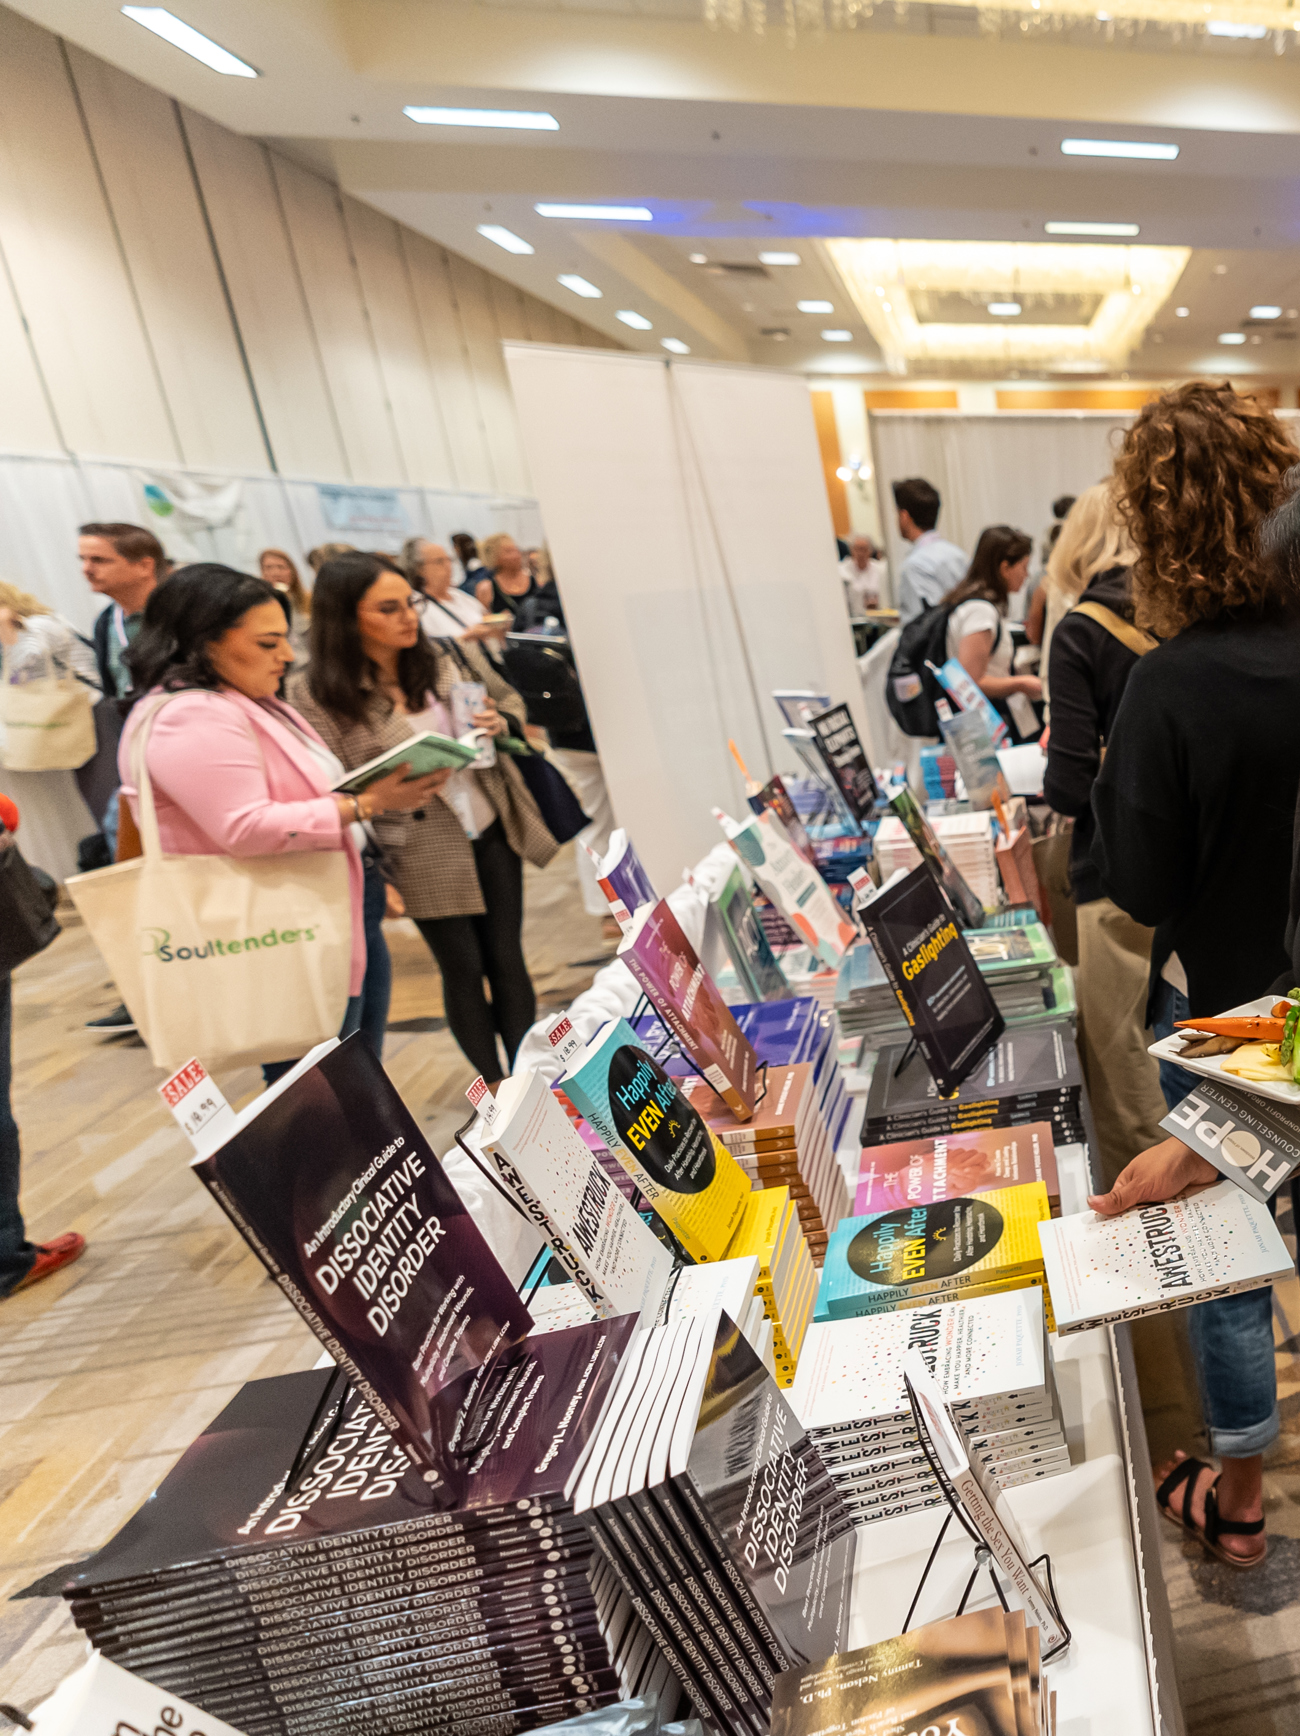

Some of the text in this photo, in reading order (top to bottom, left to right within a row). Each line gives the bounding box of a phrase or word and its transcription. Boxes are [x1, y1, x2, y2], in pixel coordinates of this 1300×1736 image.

[159, 925, 316, 962] Soultenders
[902, 922, 958, 981] Gaslighting
[627, 957, 641, 972] THE
[637, 971, 660, 997] POWER
[655, 996, 668, 1009] OF
[664, 1006, 699, 1052] ATTACHMENT
[681, 962, 706, 1022] ATTACHMENT
[550, 1020, 572, 1046] SALE
[164, 1065, 203, 1102] SALE
[616, 1059, 658, 1111] Happily
[627, 1099, 665, 1151] EVEN
[654, 1077, 678, 1113] After
[1168, 1093, 1291, 1192] HOPE
[1200, 1084, 1300, 1158] COUNSELING CENTER
[587, 1112, 660, 1201] HAPPILY EVEN AFTER
[907, 1166, 924, 1201] POWER
[932, 1139, 948, 1202] TTACHMENT
[303, 1133, 405, 1260] An Introductory Clinical Guide to
[314, 1152, 426, 1296] DISSOCIATIVE
[491, 1151, 604, 1304] AWESTRUCK
[571, 1160, 612, 1260] AWESTRUCK
[353, 1193, 424, 1301] IDENTITY
[366, 1216, 447, 1337] DISORDER
[869, 1222, 902, 1275] Happily
[902, 1207, 928, 1280] EVEN After
[868, 1275, 972, 1304] HAPPILY EVEN AFTER
[1066, 1286, 1232, 1332] AWESTRUCK
[275, 1271, 401, 1433] DISSOCIATIVE IDENTITY DISORDER
[943, 1345, 952, 1379] EMBRACING
[945, 1317, 955, 1347] WONDER
[964, 1345, 972, 1363] MORE
[965, 1314, 974, 1346] CONNECTED
[952, 1372, 960, 1390] MAKE
[743, 1404, 787, 1569] DISSOCIATIVE
[763, 1446, 794, 1564] IDENTITY
[224, 1514, 452, 1568] DISSOCIATIVE IDENTITY DISORDER
[773, 1457, 808, 1595] DISORDER
[957, 1476, 1033, 1595] Getting the Sex You Want
[631, 1596, 712, 1720] DISSOCIATIVE IDENTITY DISORDER
[799, 1657, 922, 1705] Tammy Nelson, Ph.D.
